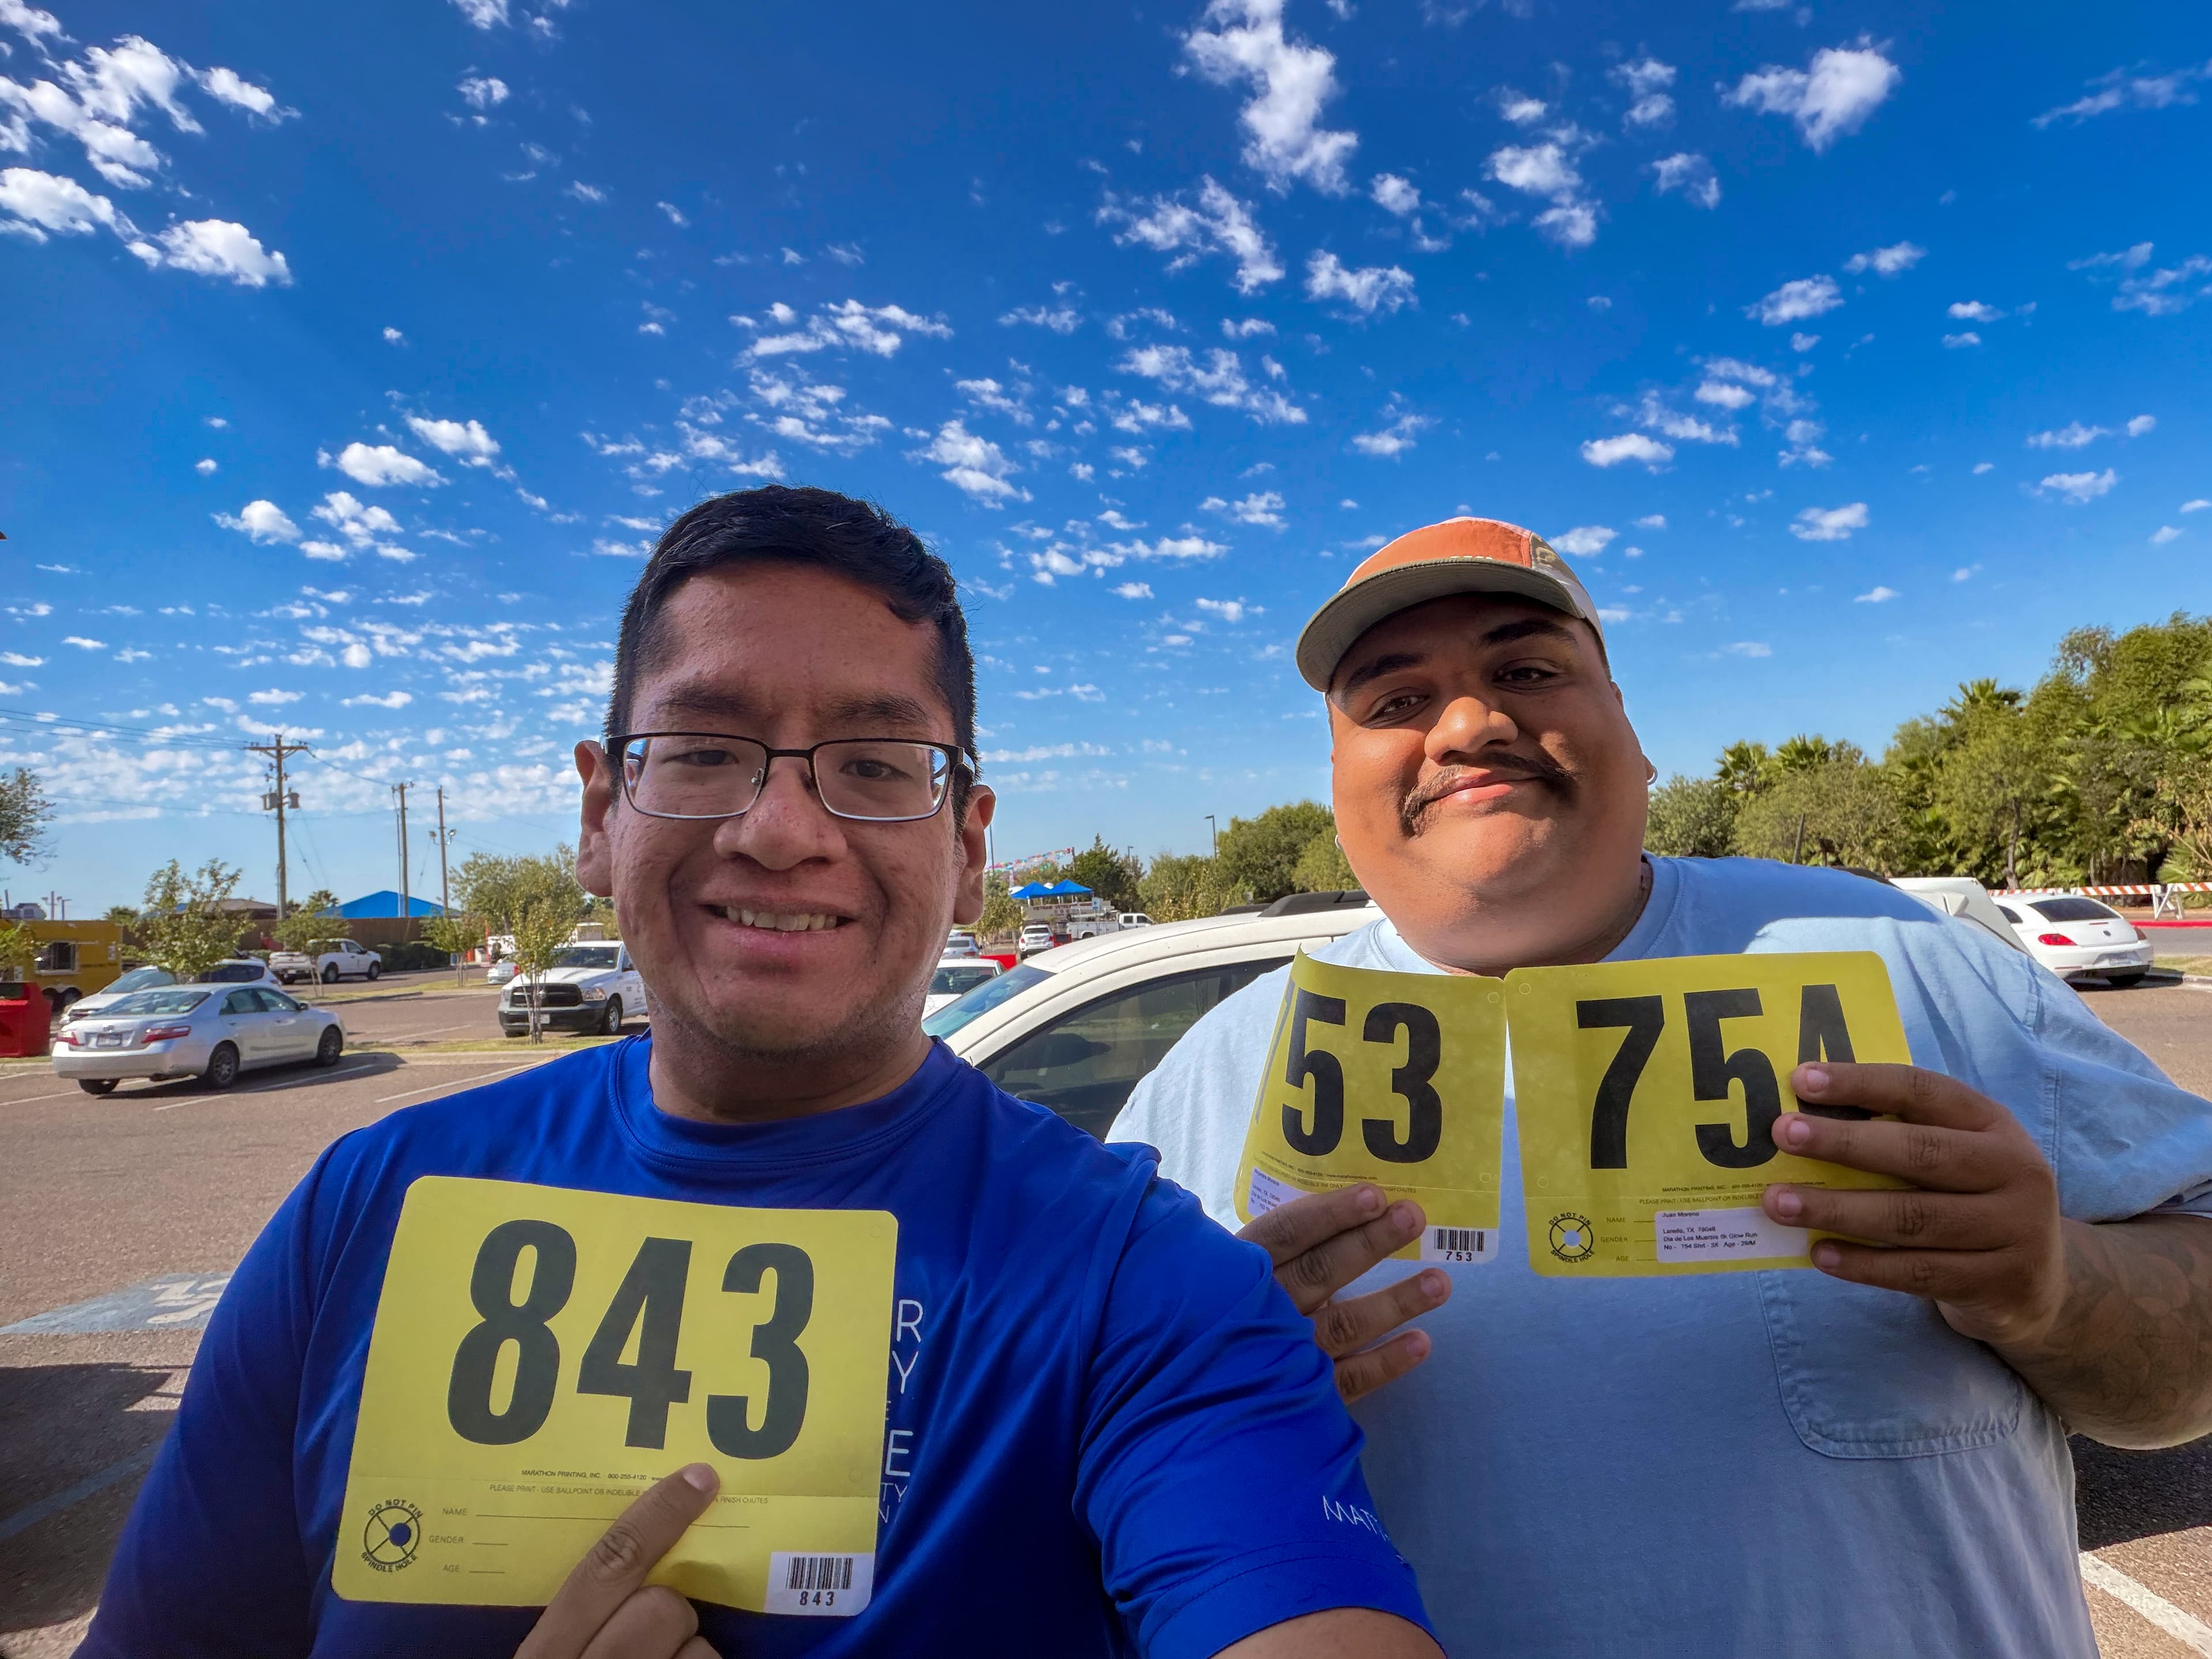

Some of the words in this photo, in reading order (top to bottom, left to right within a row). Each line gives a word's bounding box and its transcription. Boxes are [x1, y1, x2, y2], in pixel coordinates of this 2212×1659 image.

[1732, 1193, 1759, 1201] INDELIBLE
[1548, 1216, 1559, 1226] DO
[1578, 1214, 1592, 1226] PIN
[1446, 1251, 1472, 1262] 753
[1550, 1249, 1578, 1263] SPINDLE
[1579, 1249, 1595, 1262] HOLE
[447, 1219, 815, 1460] 843
[557, 1471, 588, 1479] PRINTING,
[490, 1484, 514, 1492] PLEASE
[556, 1486, 592, 1495] BALLPOINT
[605, 1488, 640, 1497] INDELIBLE
[368, 1503, 382, 1517] DO
[385, 1499, 407, 1507] NOT
[408, 1503, 423, 1519] PIN
[442, 1508, 468, 1516] NAME
[429, 1535, 464, 1544] GENDER
[361, 1551, 393, 1573] SPINDLE
[395, 1552, 418, 1571] HOLE
[442, 1564, 460, 1573] AGE
[799, 1590, 835, 1607] 843
